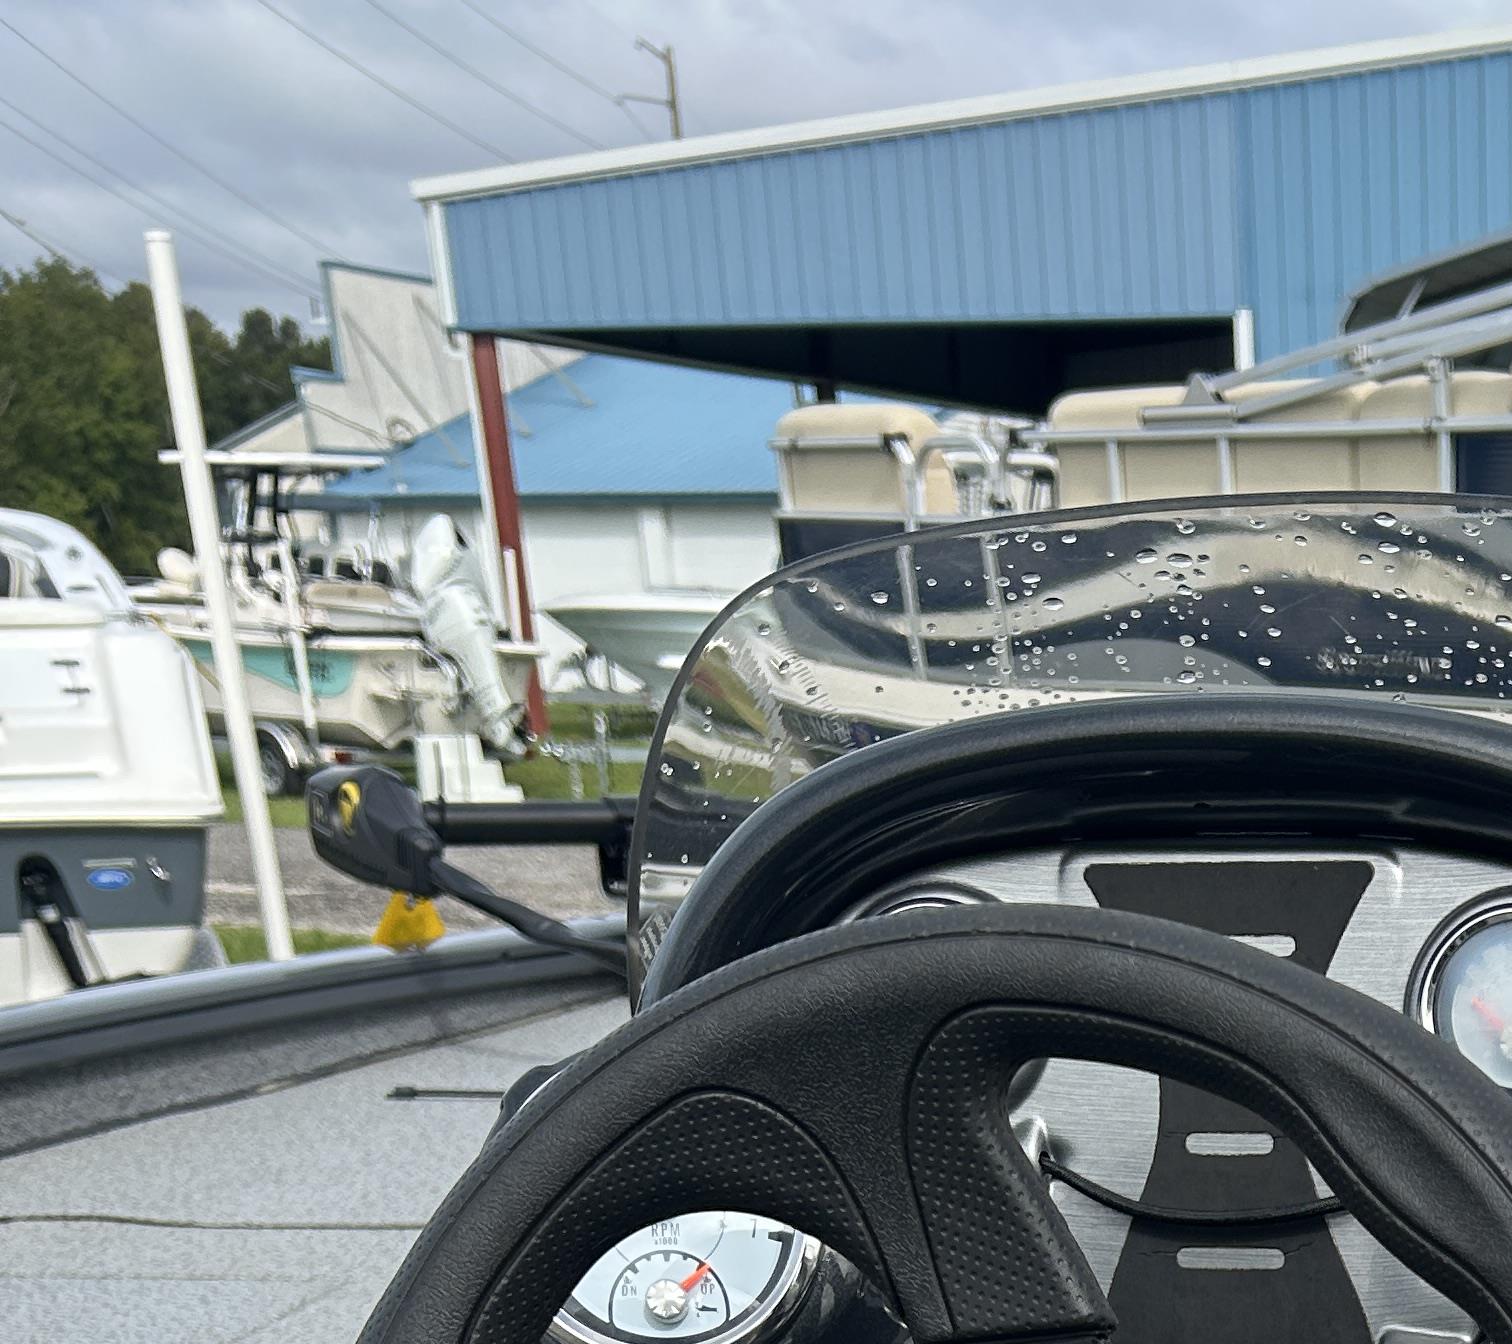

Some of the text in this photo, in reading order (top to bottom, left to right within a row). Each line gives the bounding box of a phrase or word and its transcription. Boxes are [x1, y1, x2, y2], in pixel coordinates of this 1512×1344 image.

[651, 1222, 681, 1238] RPM
[751, 1218, 757, 1239] 7
[621, 1286, 638, 1297] DN
[700, 1283, 716, 1295] UP
